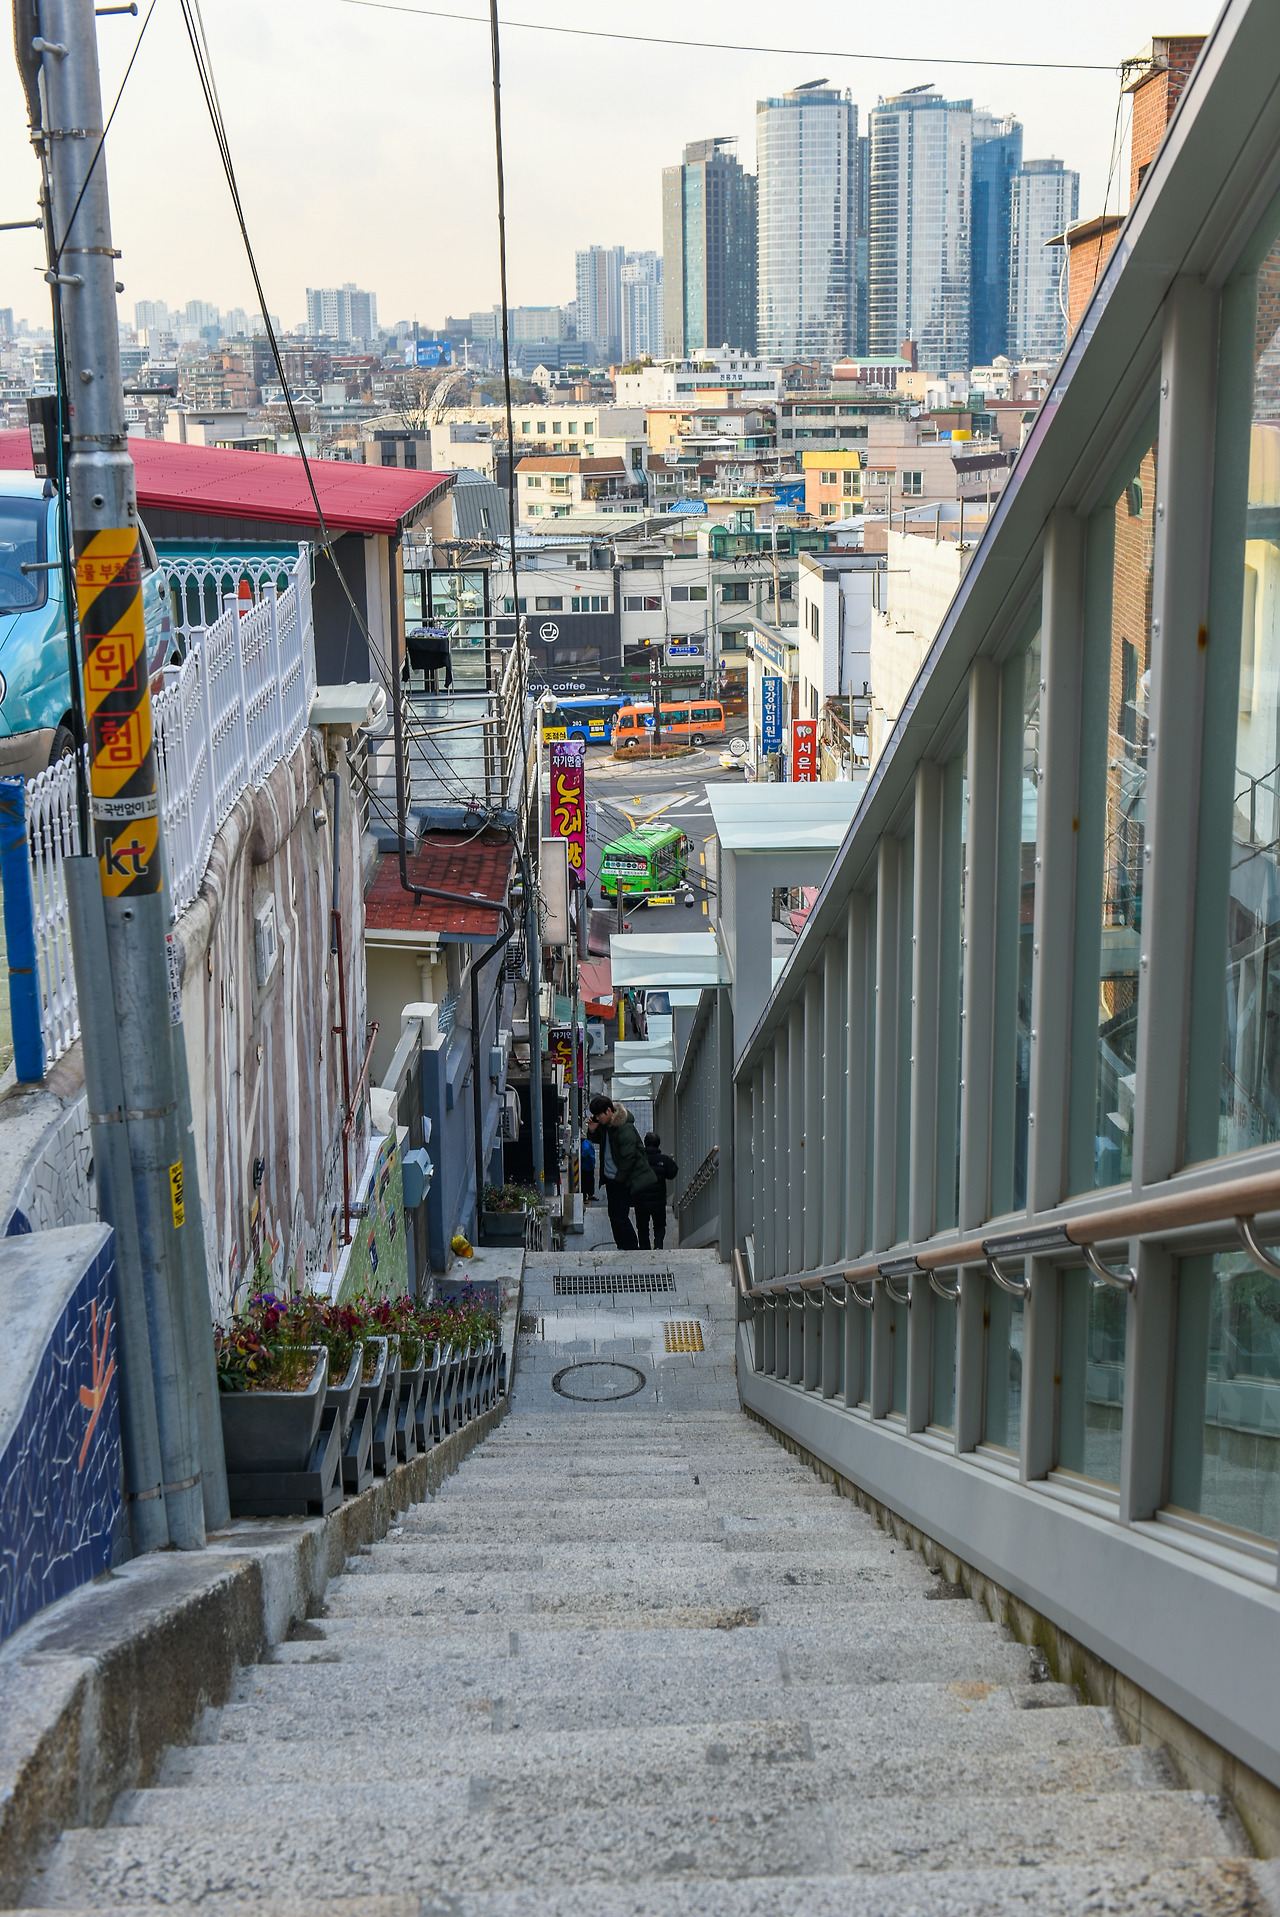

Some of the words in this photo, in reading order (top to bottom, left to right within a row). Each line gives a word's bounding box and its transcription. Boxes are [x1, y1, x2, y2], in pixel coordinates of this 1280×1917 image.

[553, 682, 586, 690] coffee
[764, 680, 777, 737] 평강한의원
[552, 755, 583, 768] 자기연출
[104, 837, 149, 876] kt
